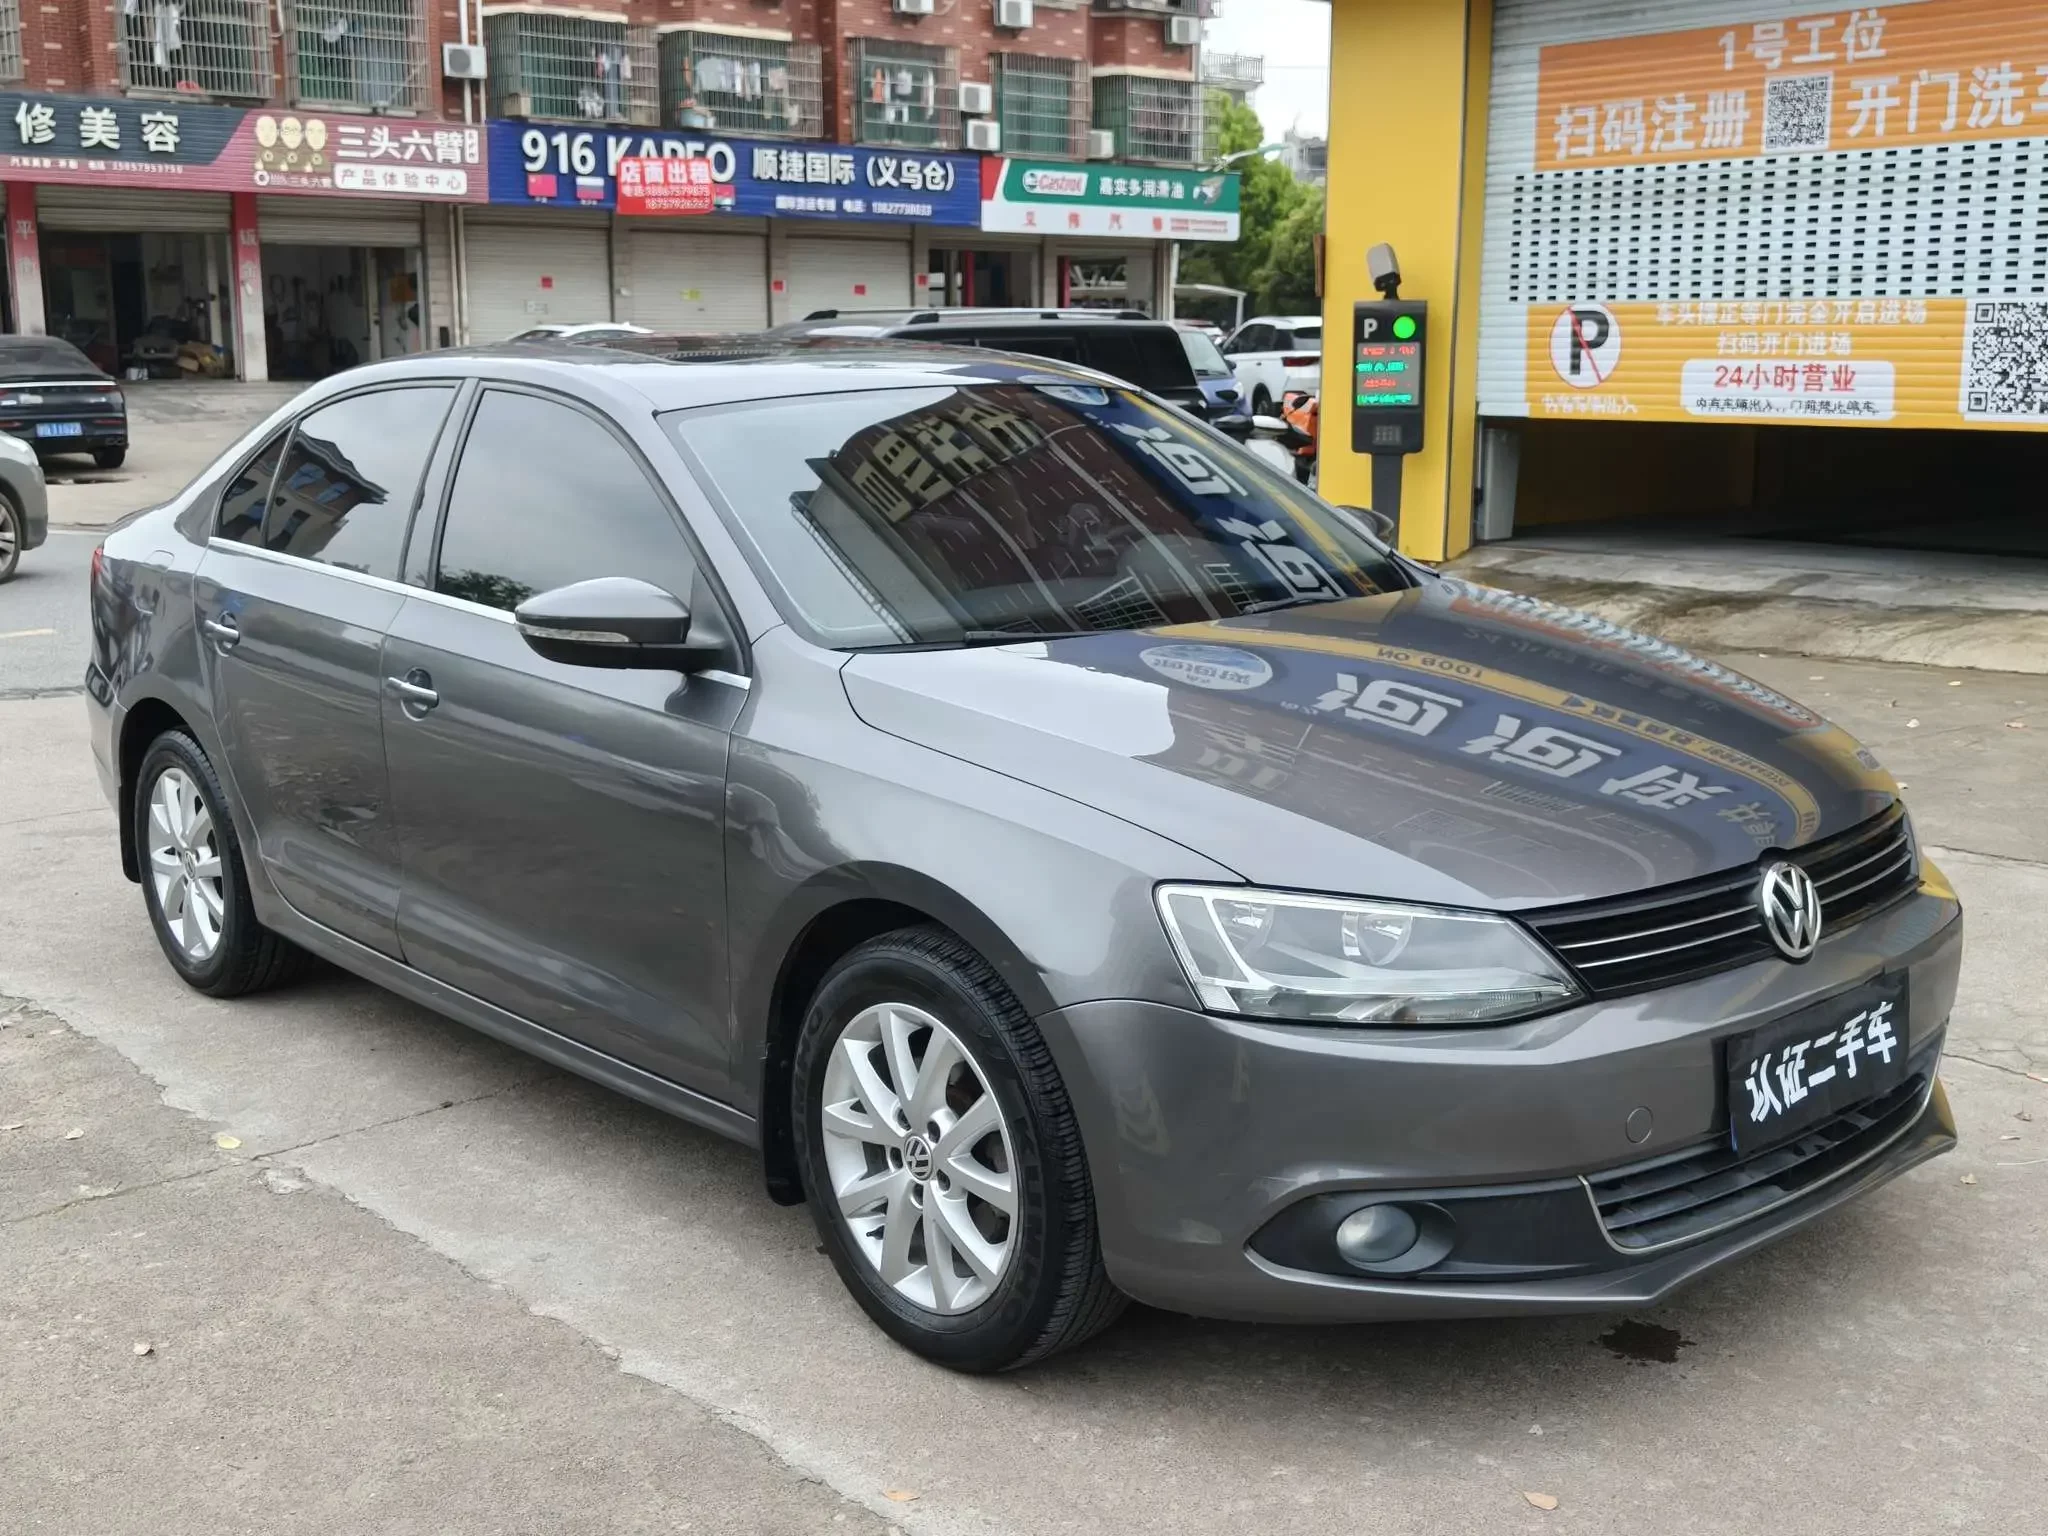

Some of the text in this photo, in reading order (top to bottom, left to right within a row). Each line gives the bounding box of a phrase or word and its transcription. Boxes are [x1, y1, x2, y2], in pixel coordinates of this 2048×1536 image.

[1717, 8, 1888, 71] 1号工位
[15, 101, 181, 153] 修美容
[1553, 88, 1751, 162] 扫码注册
[336, 126, 465, 164] 三头六臂
[521, 129, 596, 175] 916
[341, 168, 462, 190] 产品体验中心
[752, 147, 855, 185] 顺捷国际
[1364, 318, 1378, 339] P
[1716, 331, 1853, 356] 扫码开门进场
[1713, 363, 1857, 392] 24小时营业
[1744, 1001, 1898, 1122] 认证二手车
